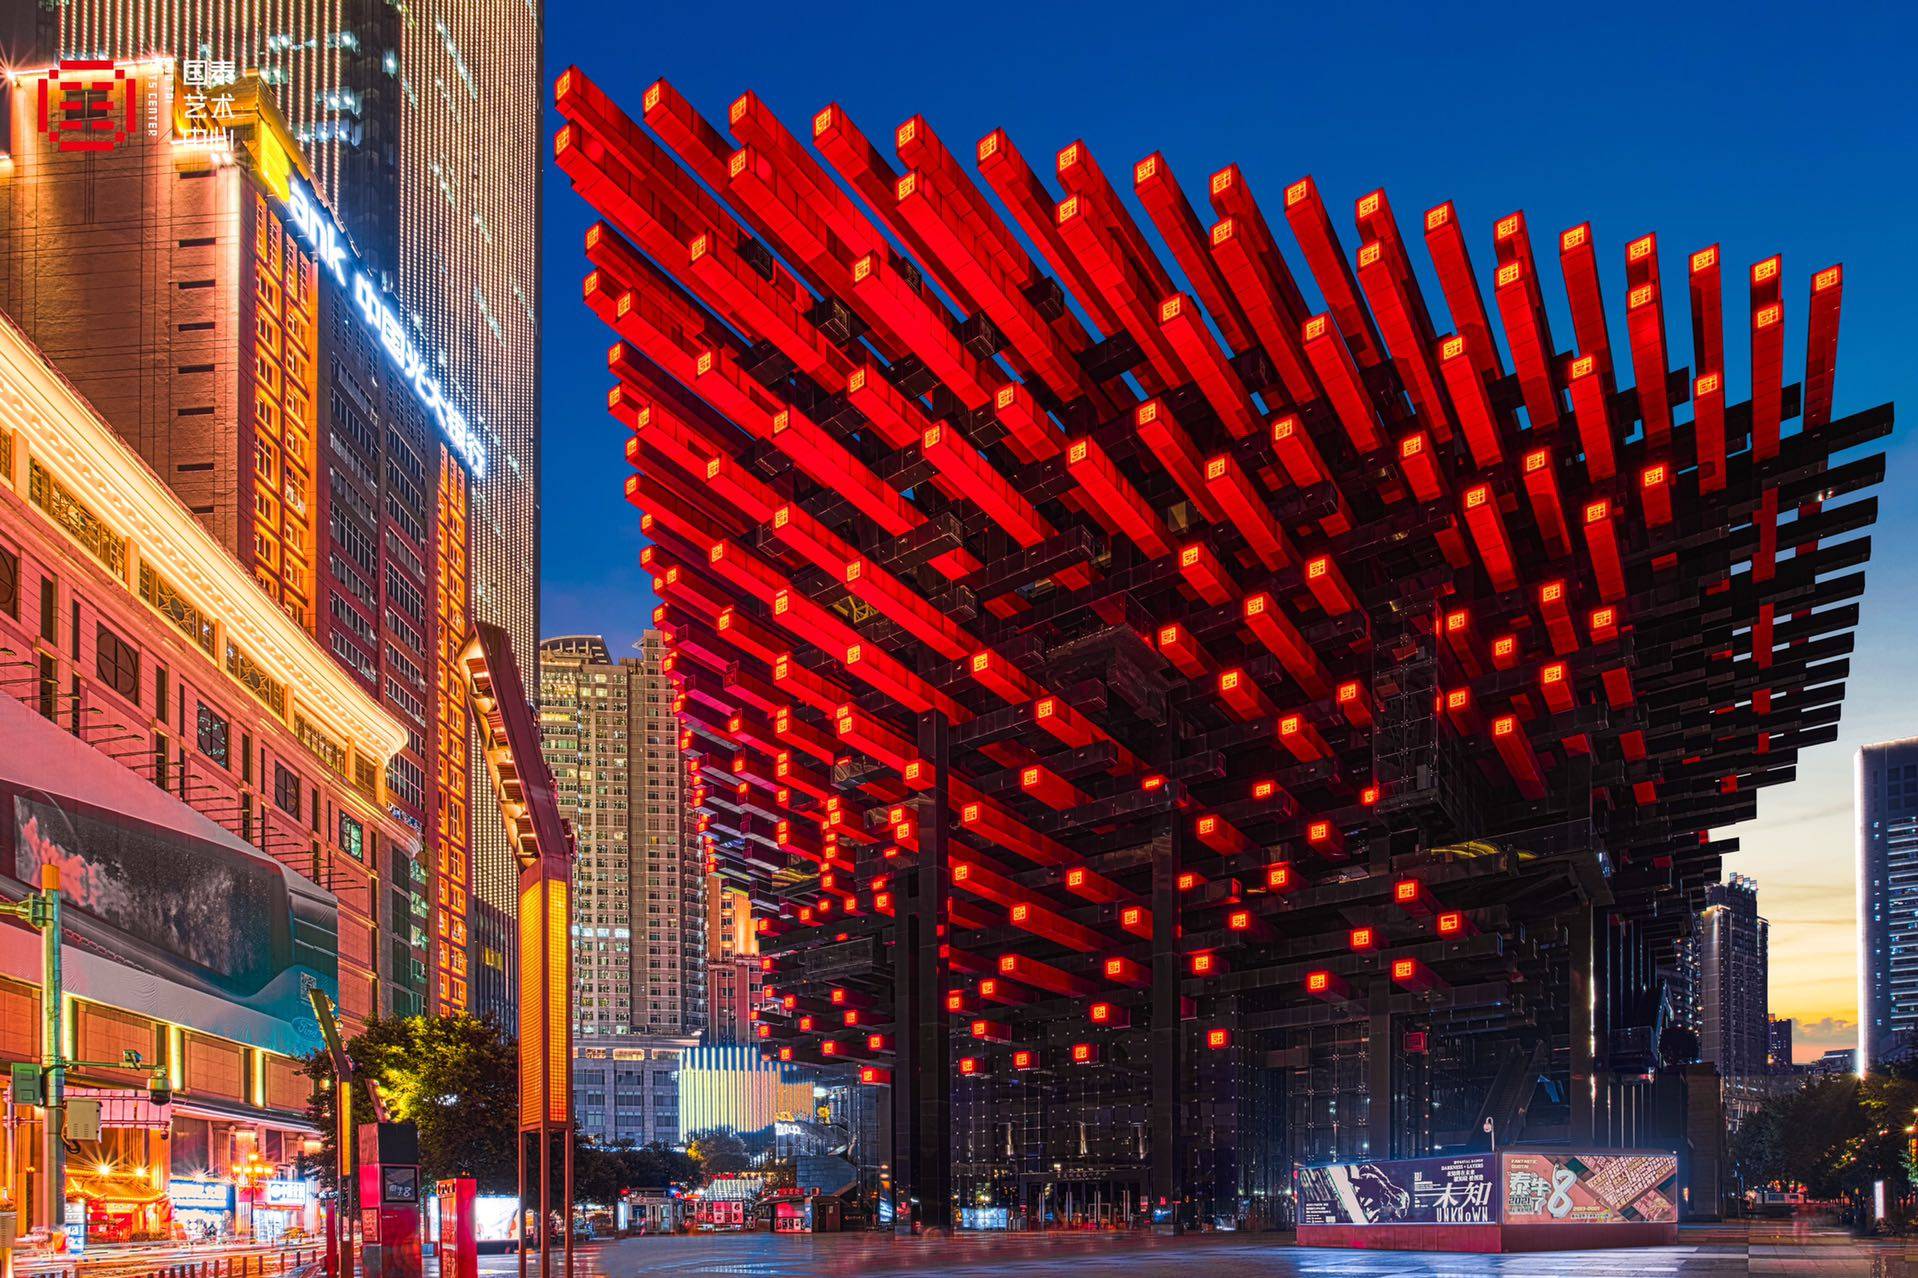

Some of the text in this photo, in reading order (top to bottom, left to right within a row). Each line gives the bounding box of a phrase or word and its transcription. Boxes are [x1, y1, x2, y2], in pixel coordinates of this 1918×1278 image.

[354, 270, 485, 478] 中国光大银行
